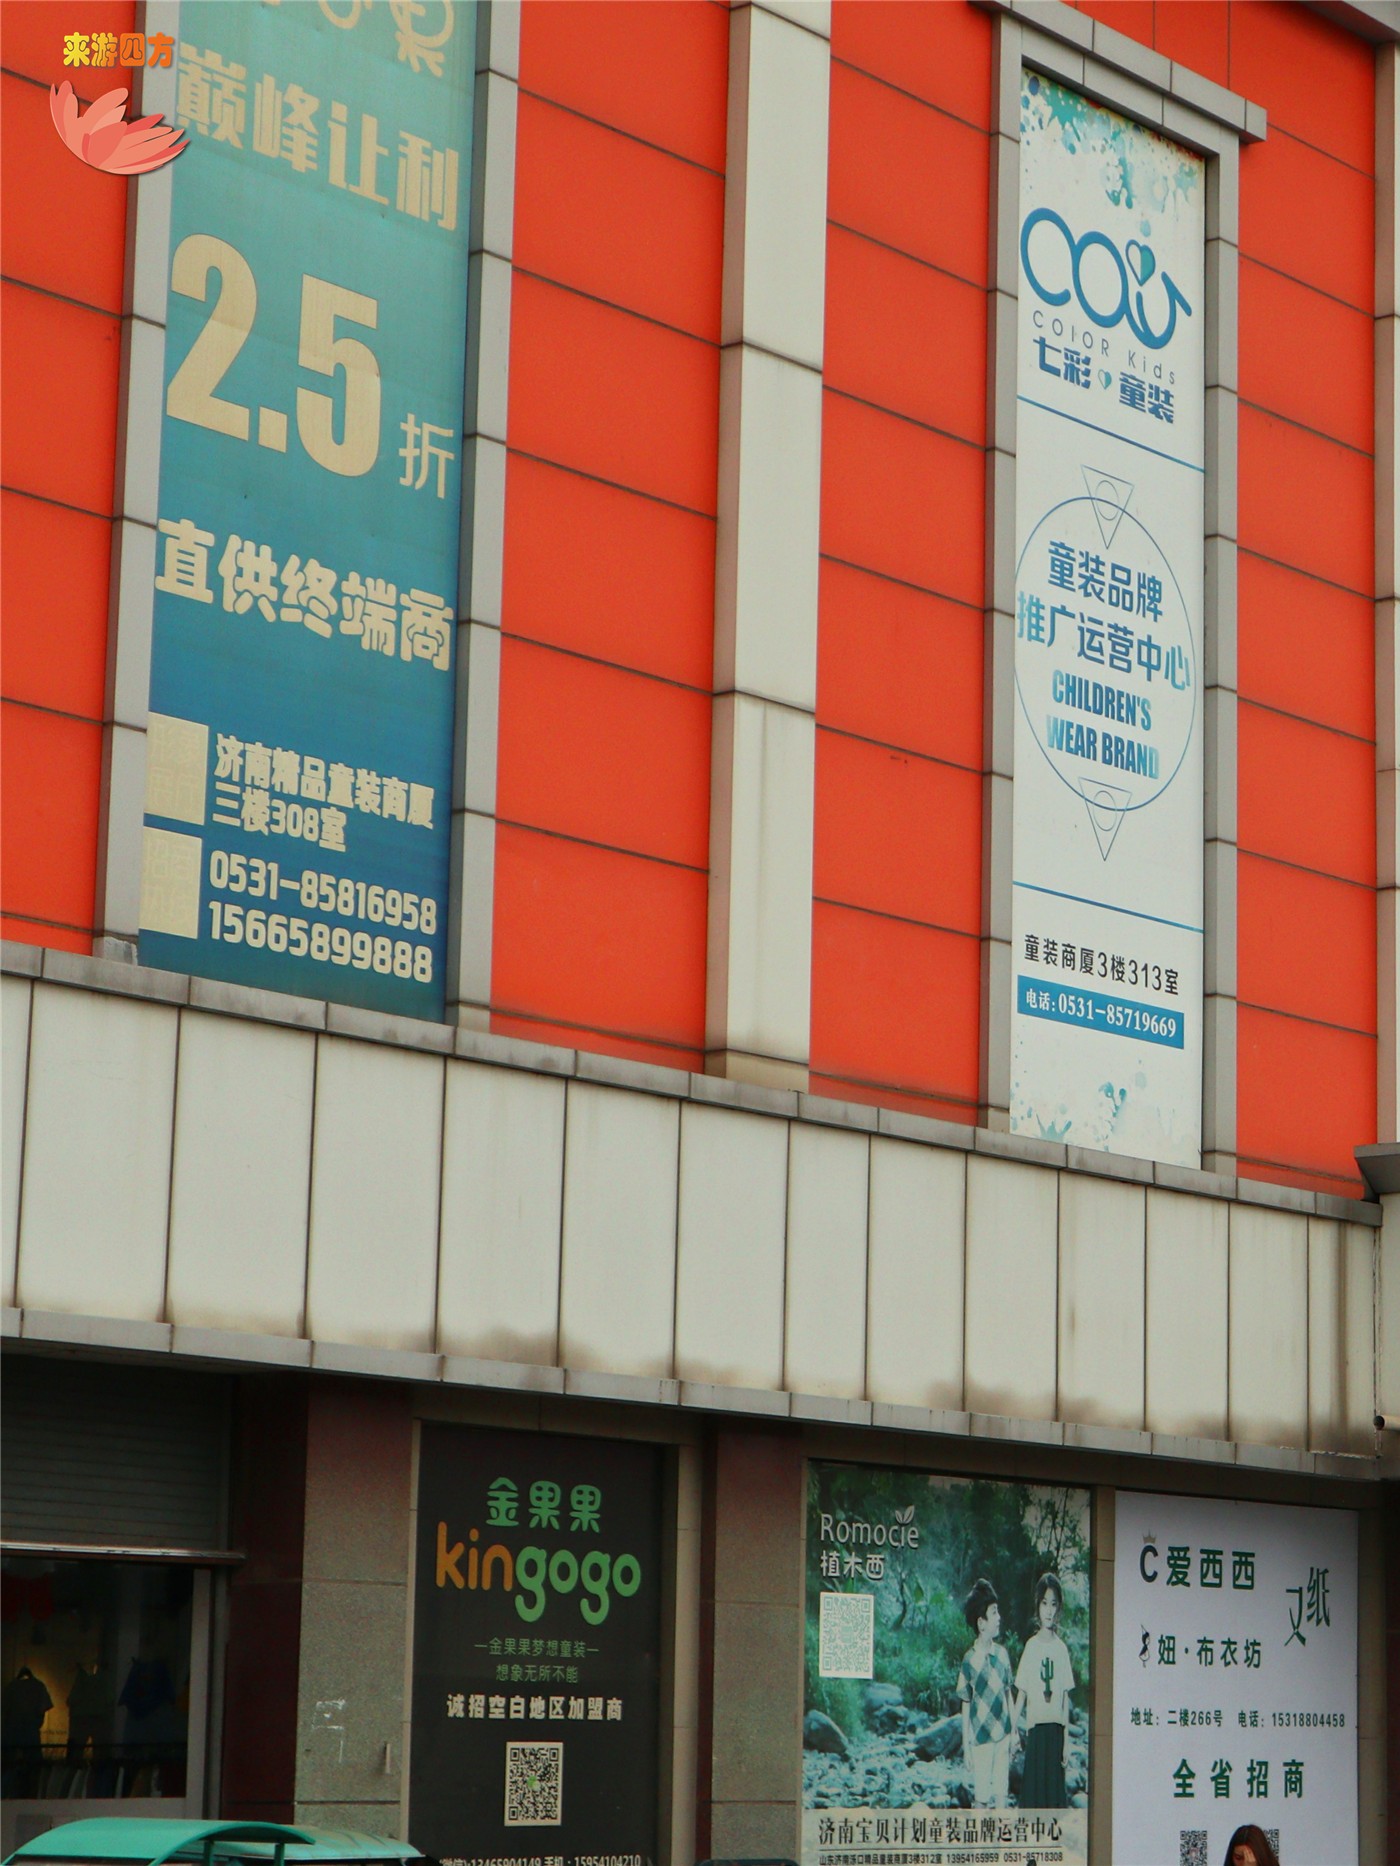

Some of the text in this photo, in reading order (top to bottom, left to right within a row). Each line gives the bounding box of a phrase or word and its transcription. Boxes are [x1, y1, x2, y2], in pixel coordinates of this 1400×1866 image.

[177, 42, 459, 231] 巅峰让利
[1128, 349, 1175, 384] Kids
[155, 518, 453, 671] 直供终端商
[1047, 540, 1163, 623] 童装品牌
[1017, 591, 1191, 691] 推广运营中心
[1052, 669, 1152, 731] CHILDREN'S
[1046, 714, 1160, 780] WEAR BRAND
[214, 733, 434, 829] 济南精品童装商厦
[212, 781, 346, 852] 三楼308室
[209, 850, 437, 935] 0531-85816958
[209, 901, 432, 983] 15665899888
[1024, 934, 1179, 996] 童装商厦3楼313室
[486, 1477, 601, 1533] 金果果
[436, 1521, 641, 1625] kingogo
[820, 1550, 885, 1580] 植木西
[496, 1664, 579, 1684] 想象无所不能
[447, 1694, 623, 1721] 诚招空白地区加盟商
[1172, 1758, 1304, 1799] 全省招商
[819, 1817, 1063, 1846] 济南宝贝计划童装品牌运营中心
